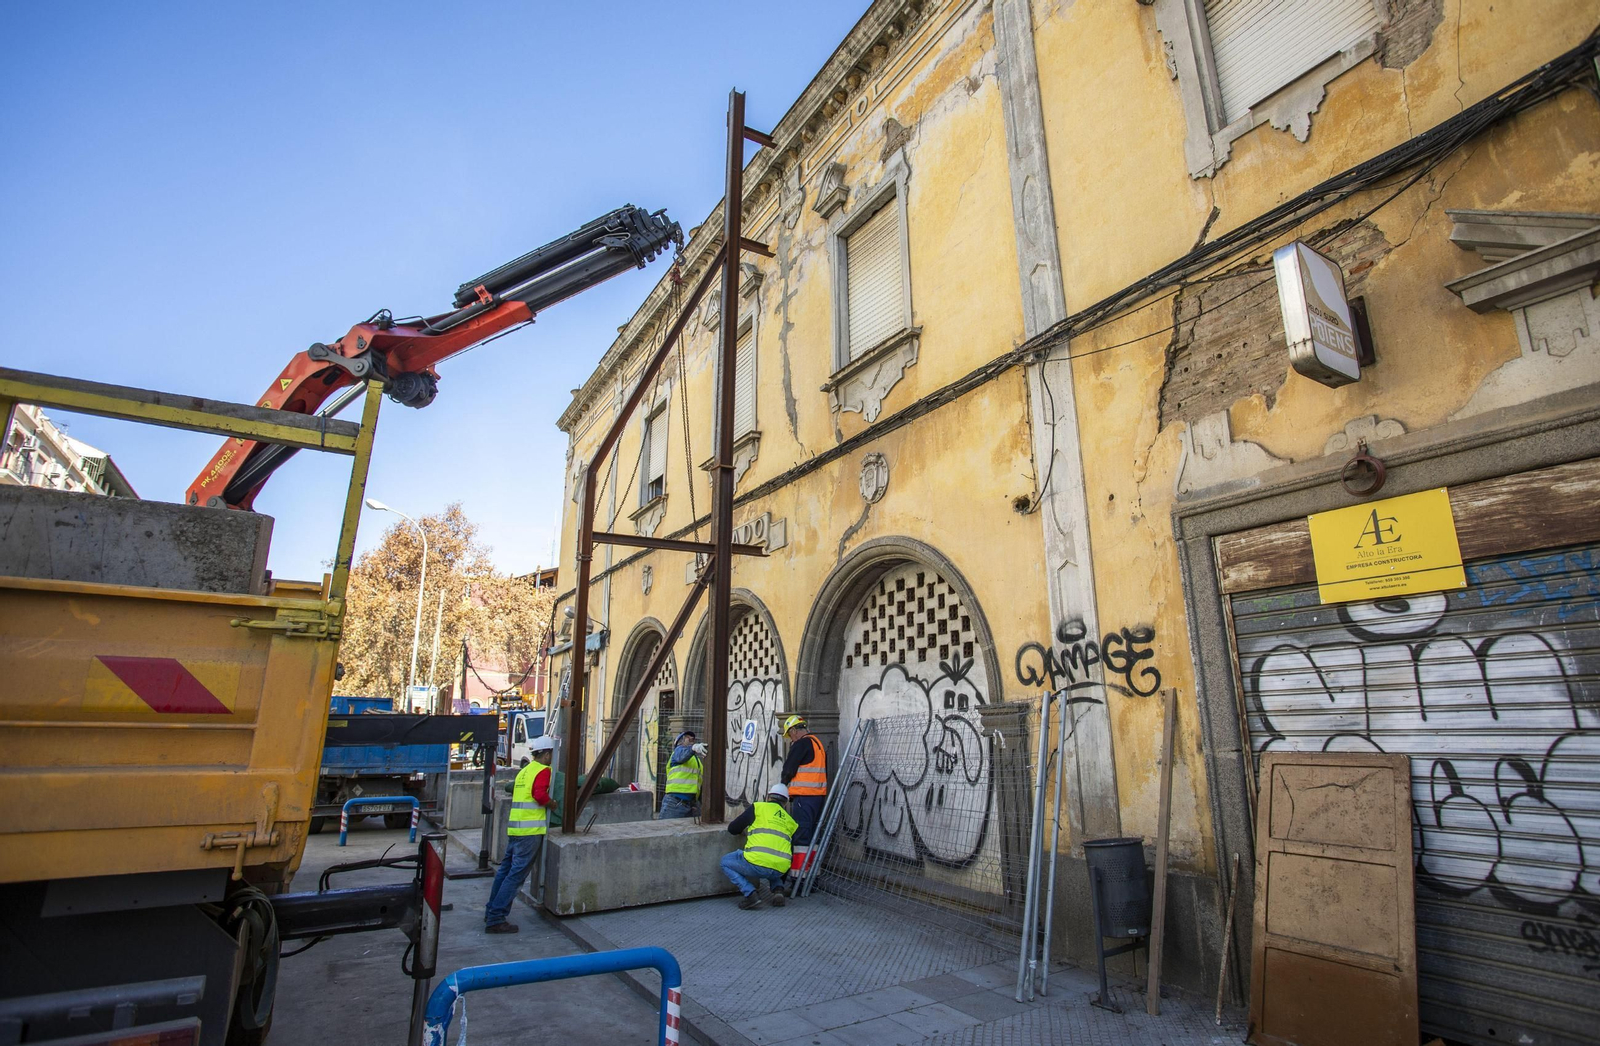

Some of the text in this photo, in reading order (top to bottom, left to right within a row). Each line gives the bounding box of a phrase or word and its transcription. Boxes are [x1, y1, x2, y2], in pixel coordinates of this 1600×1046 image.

[1309, 312, 1354, 355] POTENS
[200, 450, 231, 488] PK 44002
[1357, 545, 1403, 559] Alto la Era
[1373, 554, 1423, 566] CONSTRUCTORA
